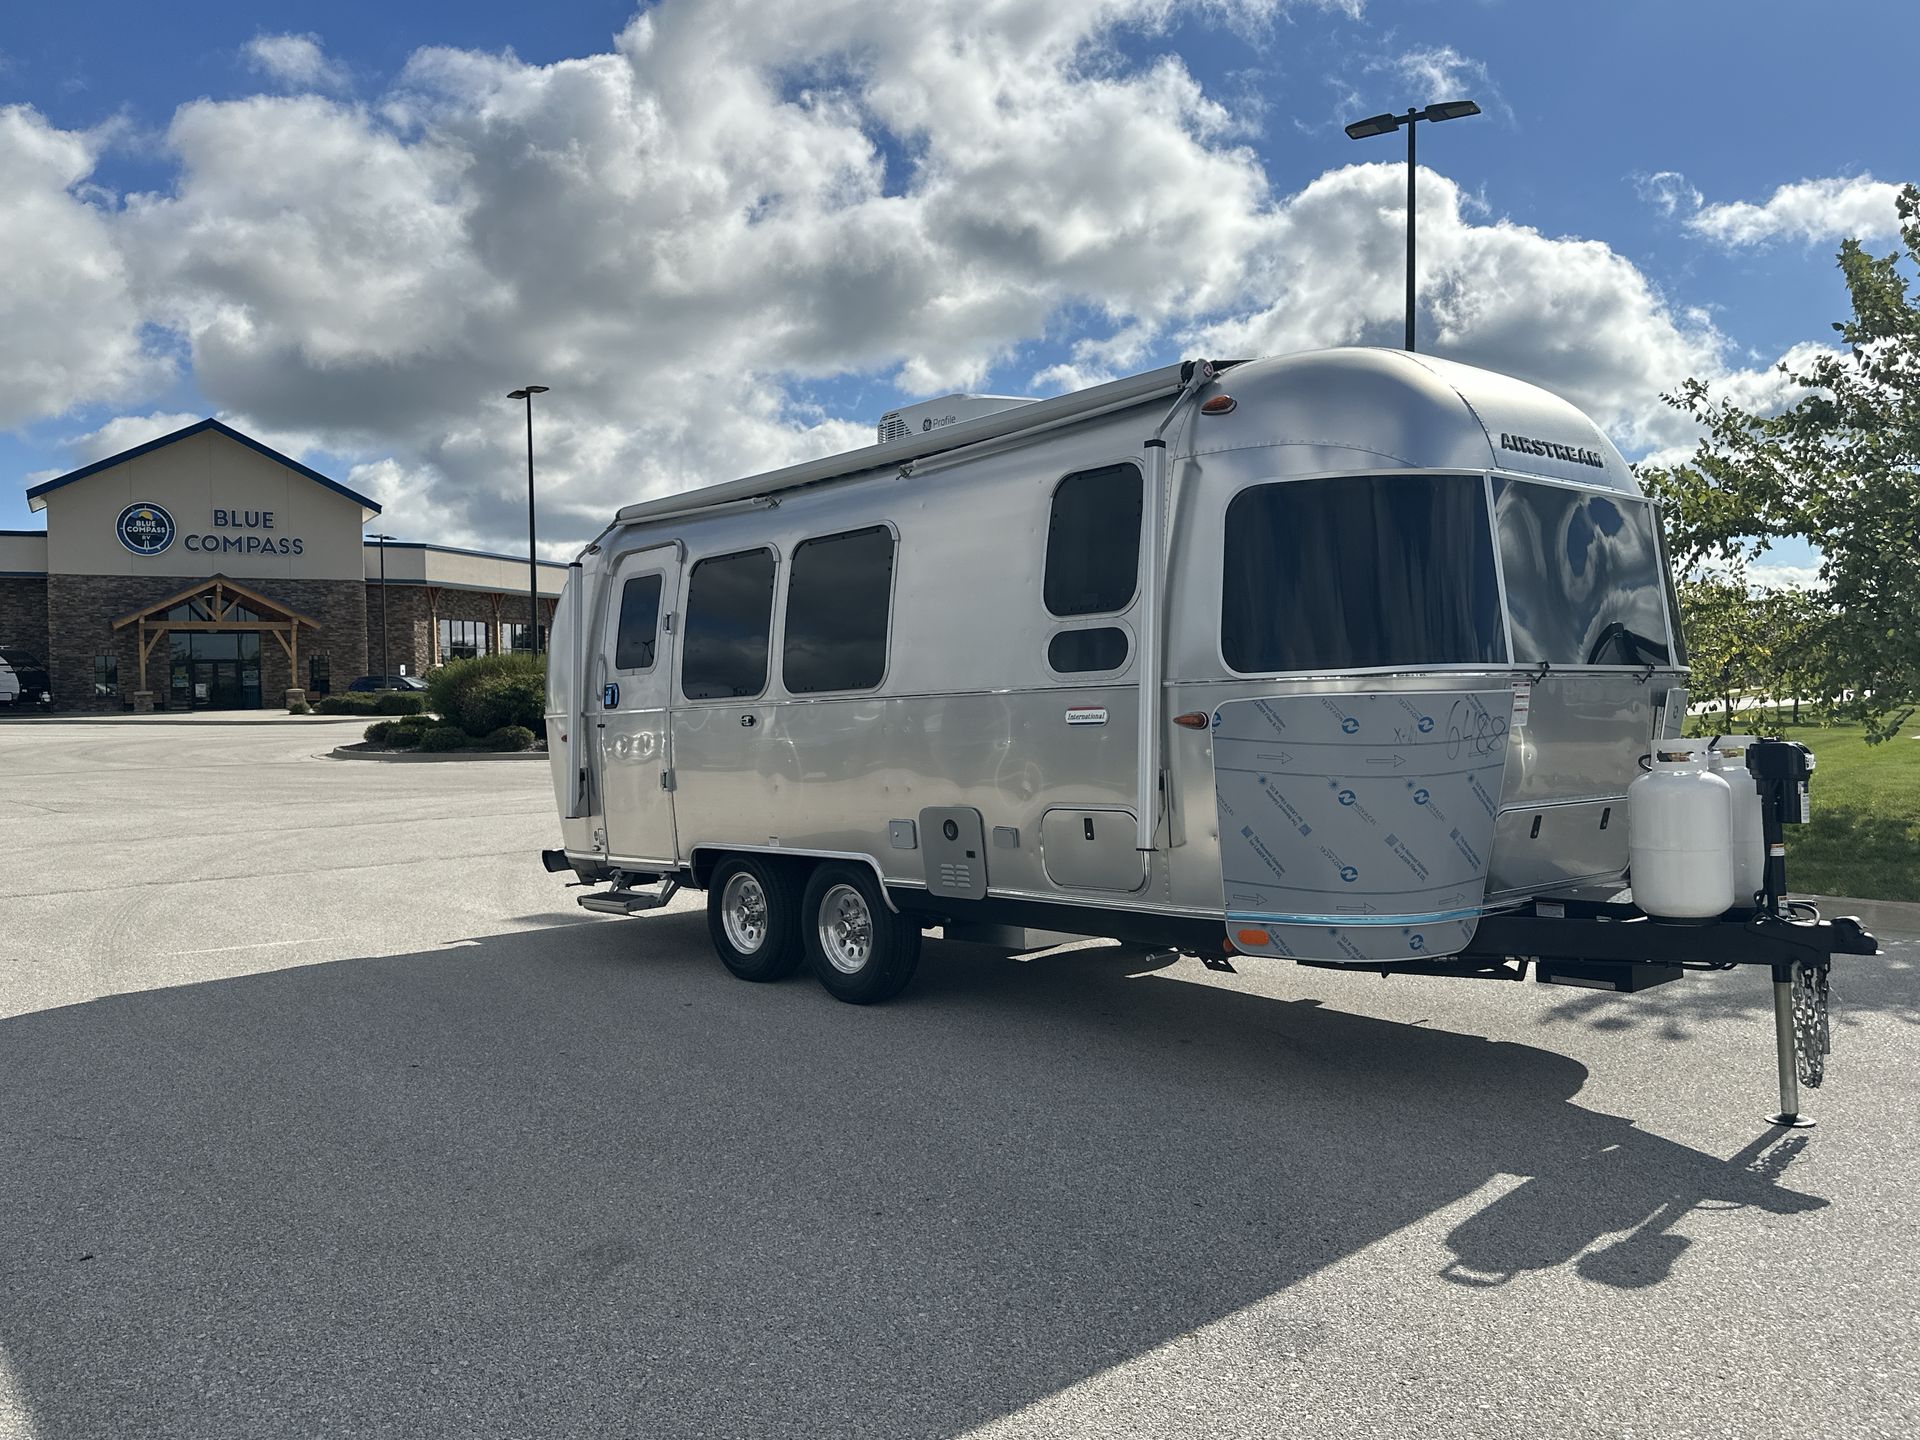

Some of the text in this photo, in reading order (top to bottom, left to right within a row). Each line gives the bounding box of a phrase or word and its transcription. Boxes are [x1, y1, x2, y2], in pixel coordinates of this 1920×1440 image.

[933, 415, 956, 427] Profile
[1501, 433, 1604, 468] AIRSTREAM
[213, 509, 274, 529] BLUE
[184, 534, 304, 555] COMPASS
[1068, 711, 1106, 720] International
